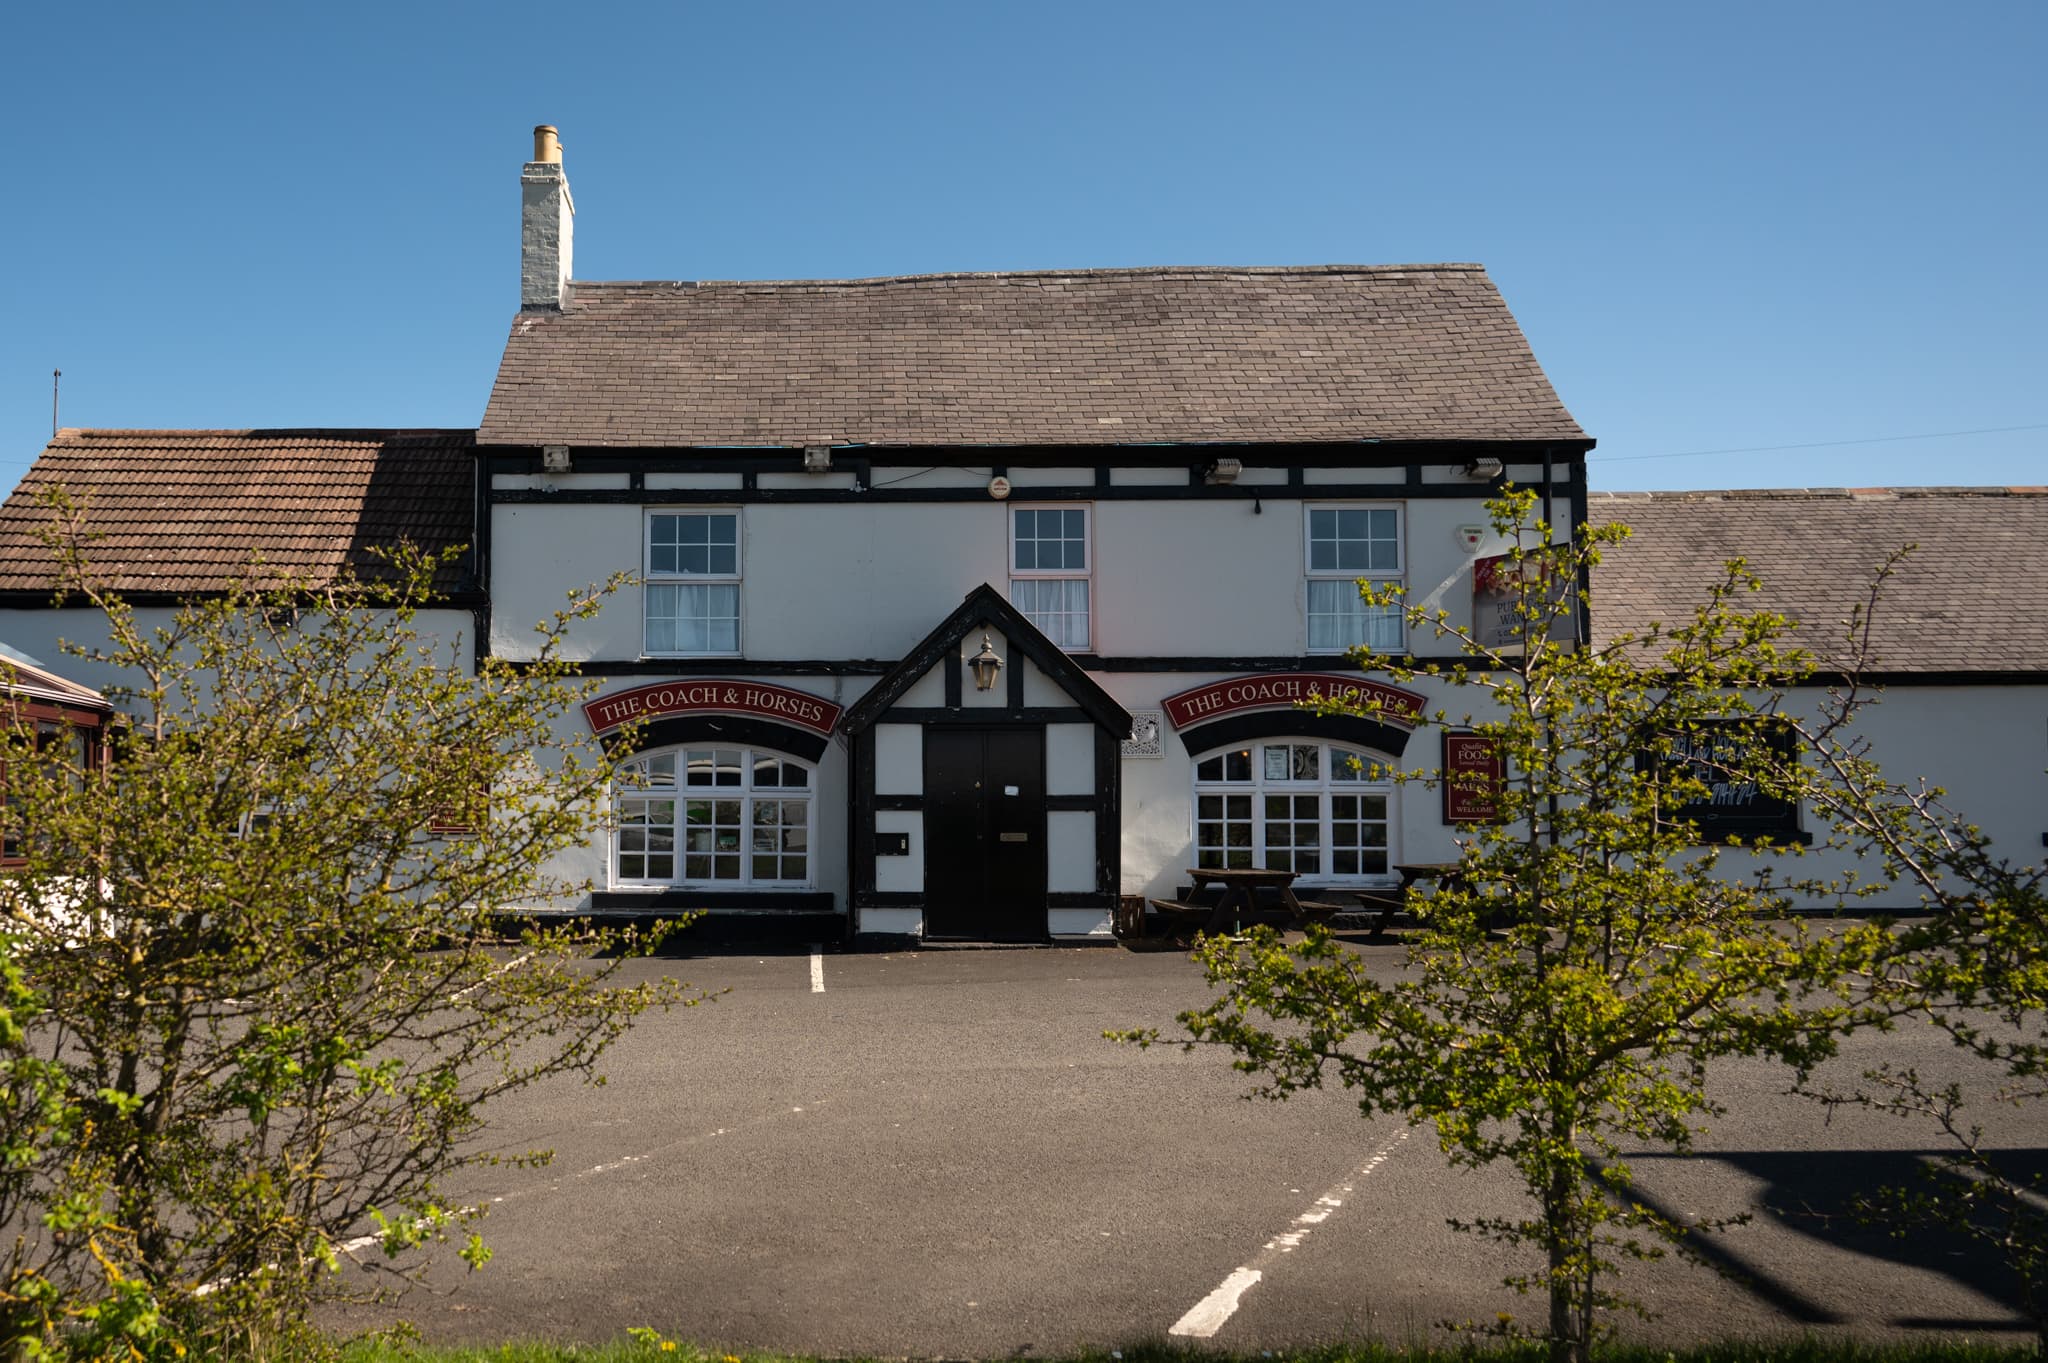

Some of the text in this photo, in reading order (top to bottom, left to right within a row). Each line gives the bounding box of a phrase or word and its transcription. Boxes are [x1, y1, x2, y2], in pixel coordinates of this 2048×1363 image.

[600, 687, 824, 722] THE COACH & HORSES
[1182, 691, 1224, 717] THE
[1227, 681, 1300, 704] COACH
[1306, 681, 1321, 697] &
